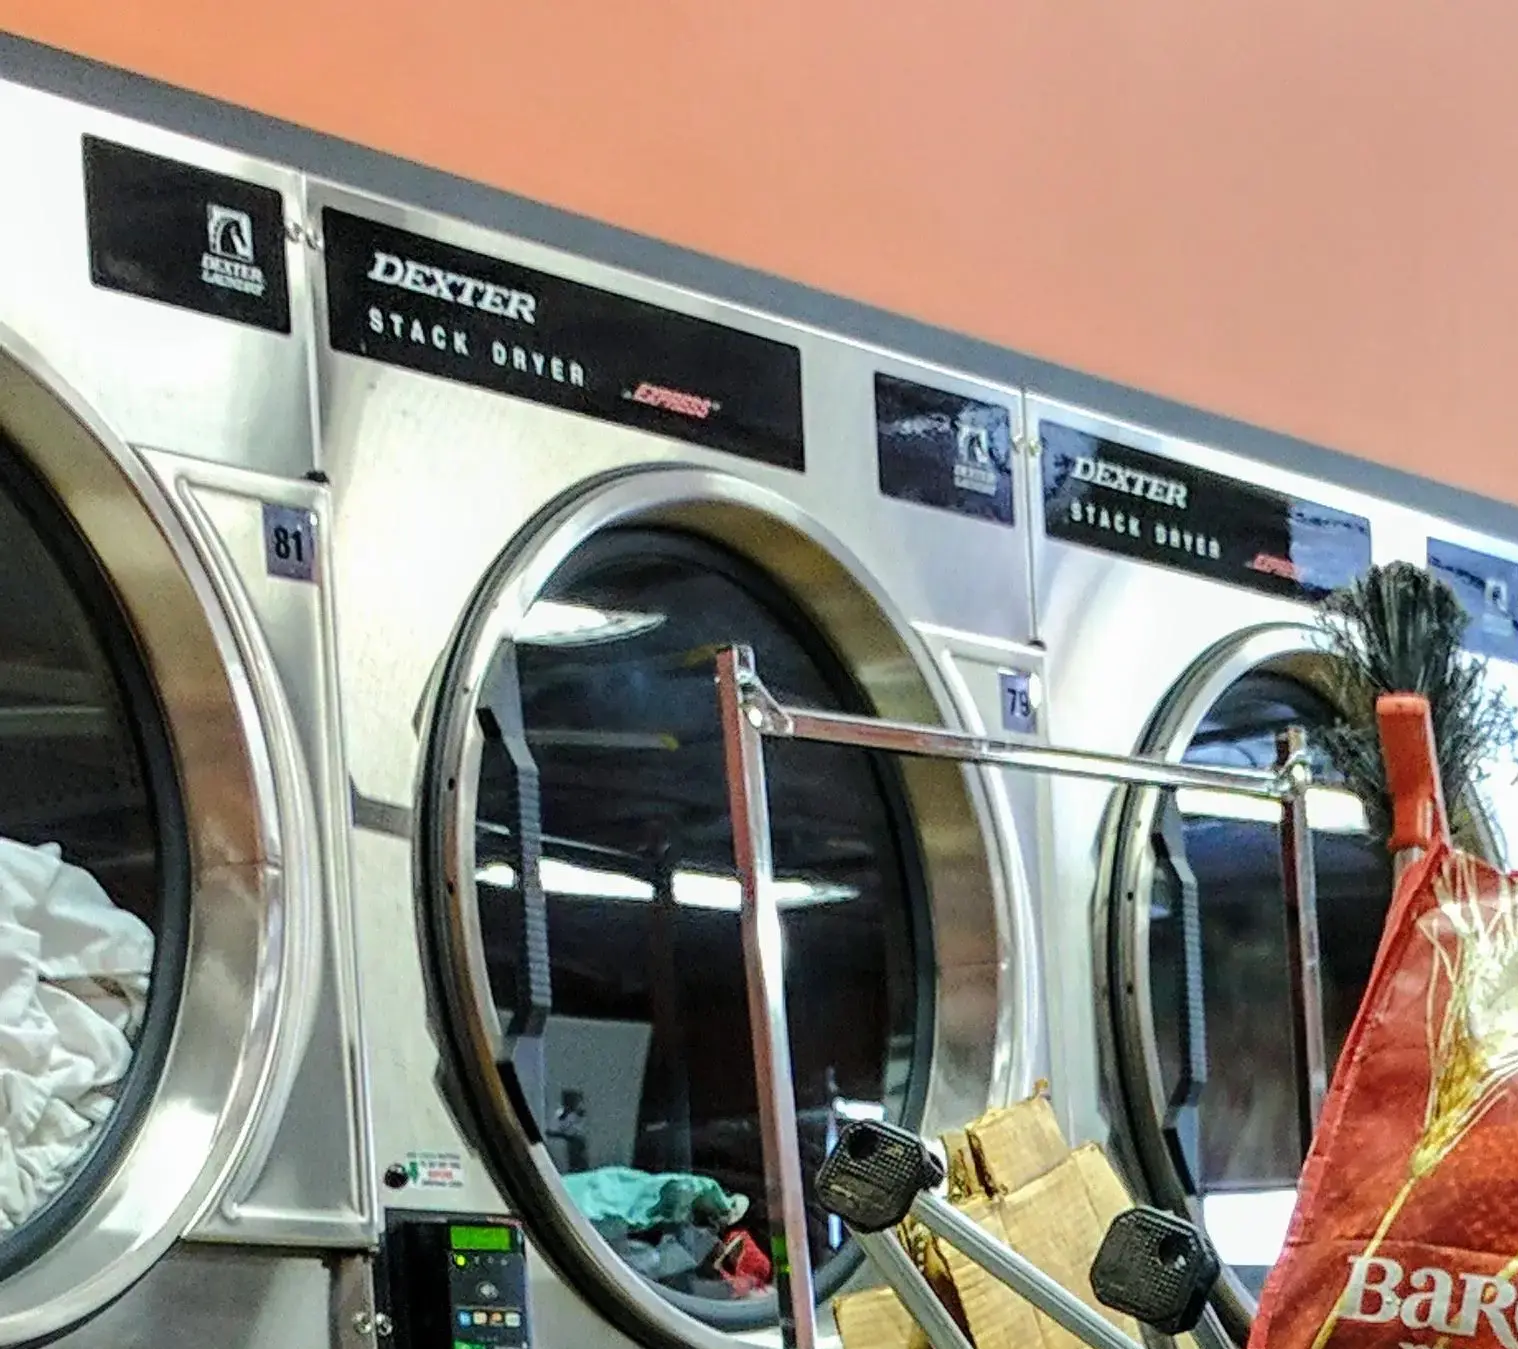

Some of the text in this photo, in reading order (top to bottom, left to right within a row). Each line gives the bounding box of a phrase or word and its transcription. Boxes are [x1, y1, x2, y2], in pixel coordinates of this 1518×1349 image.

[367, 251, 537, 324] DEXTER
[368, 308, 584, 387] STACK DRYER
[1072, 457, 1188, 509] DEXTER
[274, 525, 303, 562] 81
[1070, 503, 1221, 560] STACK DRYER
